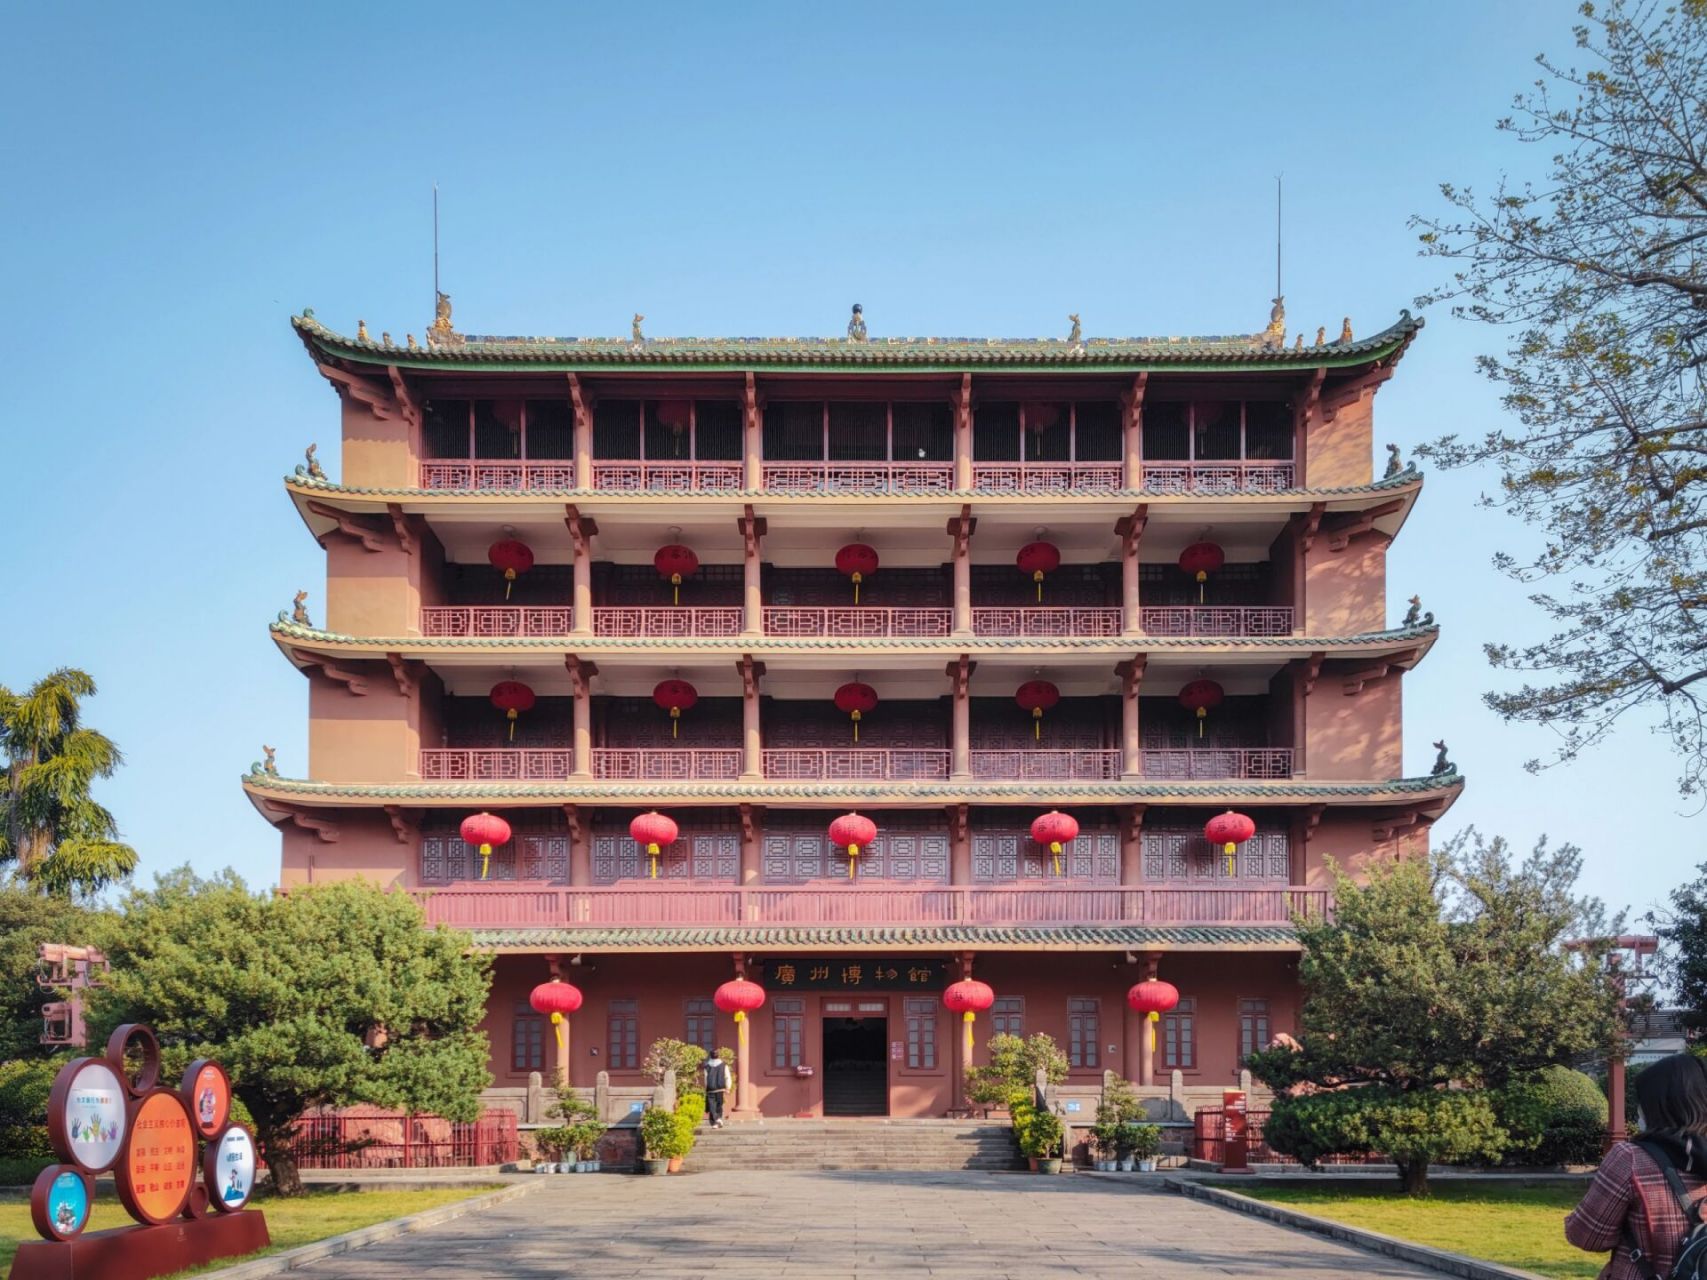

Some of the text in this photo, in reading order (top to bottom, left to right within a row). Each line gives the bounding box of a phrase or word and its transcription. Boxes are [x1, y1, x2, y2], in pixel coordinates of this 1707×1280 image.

[775, 964, 932, 985] 廣州博物館
